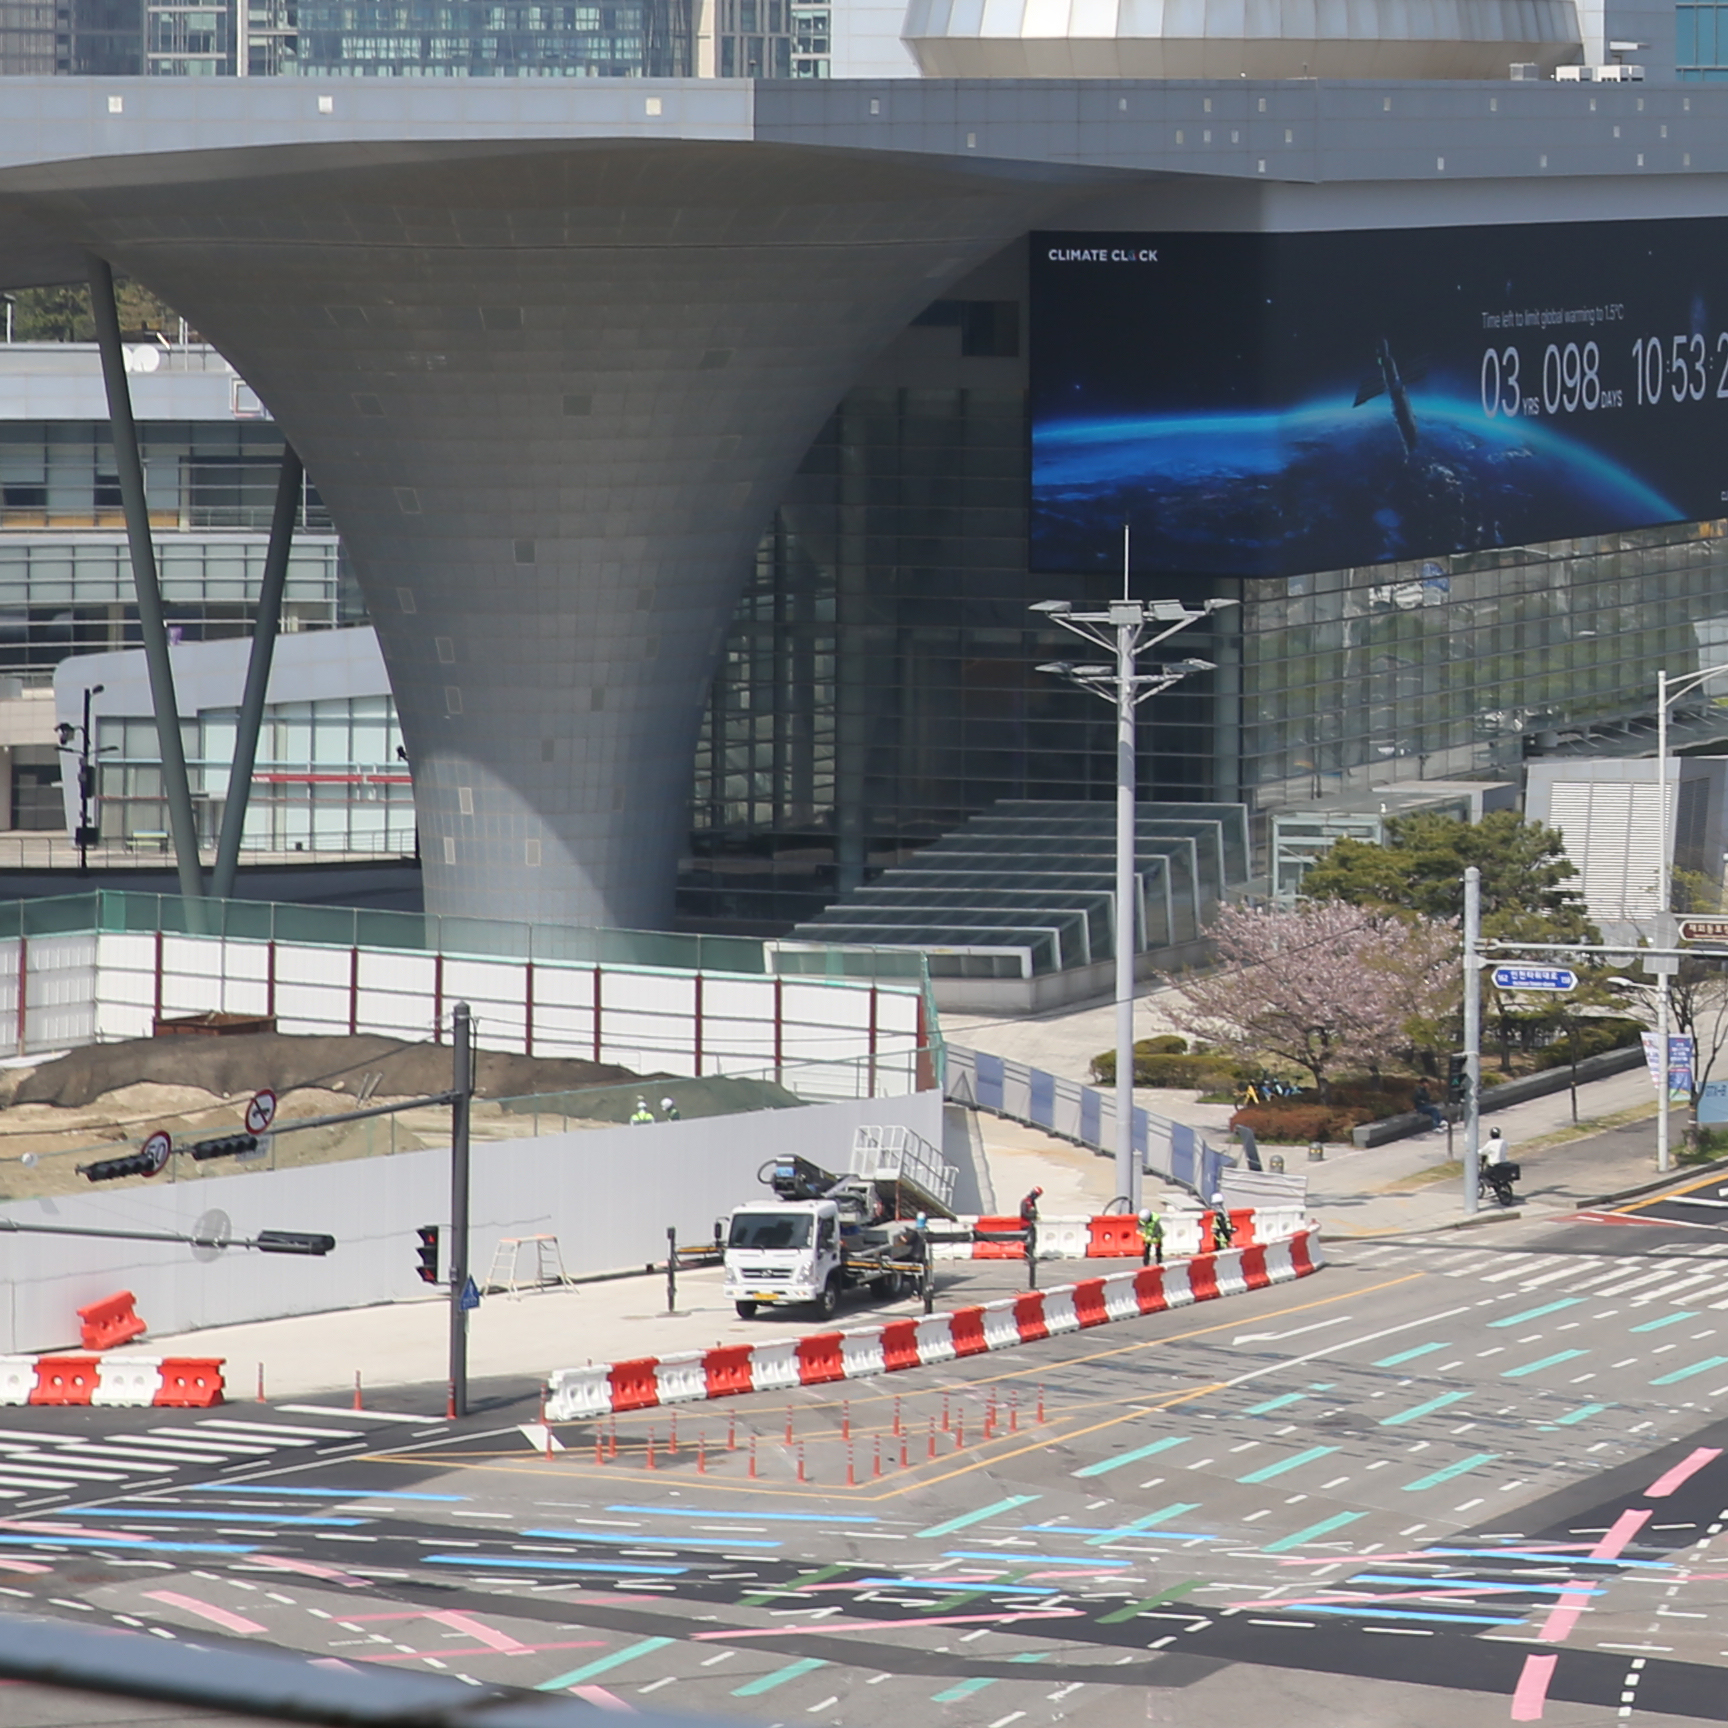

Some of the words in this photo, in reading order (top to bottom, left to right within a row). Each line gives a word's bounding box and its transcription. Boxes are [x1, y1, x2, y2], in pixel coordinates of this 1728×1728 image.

[1048, 249, 1108, 262] CLIMATE
[1481, 311, 1501, 329] Time
[1502, 309, 1515, 328] left
[1515, 310, 1524, 327] to
[1525, 308, 1541, 327] limit
[1540, 307, 1564, 329] global
[1564, 305, 1596, 327] warming
[1596, 306, 1604, 322] to
[1481, 346, 1521, 419] 03
[1522, 397, 1540, 416] YRS
[1543, 340, 1600, 415] 098
[1600, 389, 1623, 410] DAYS
